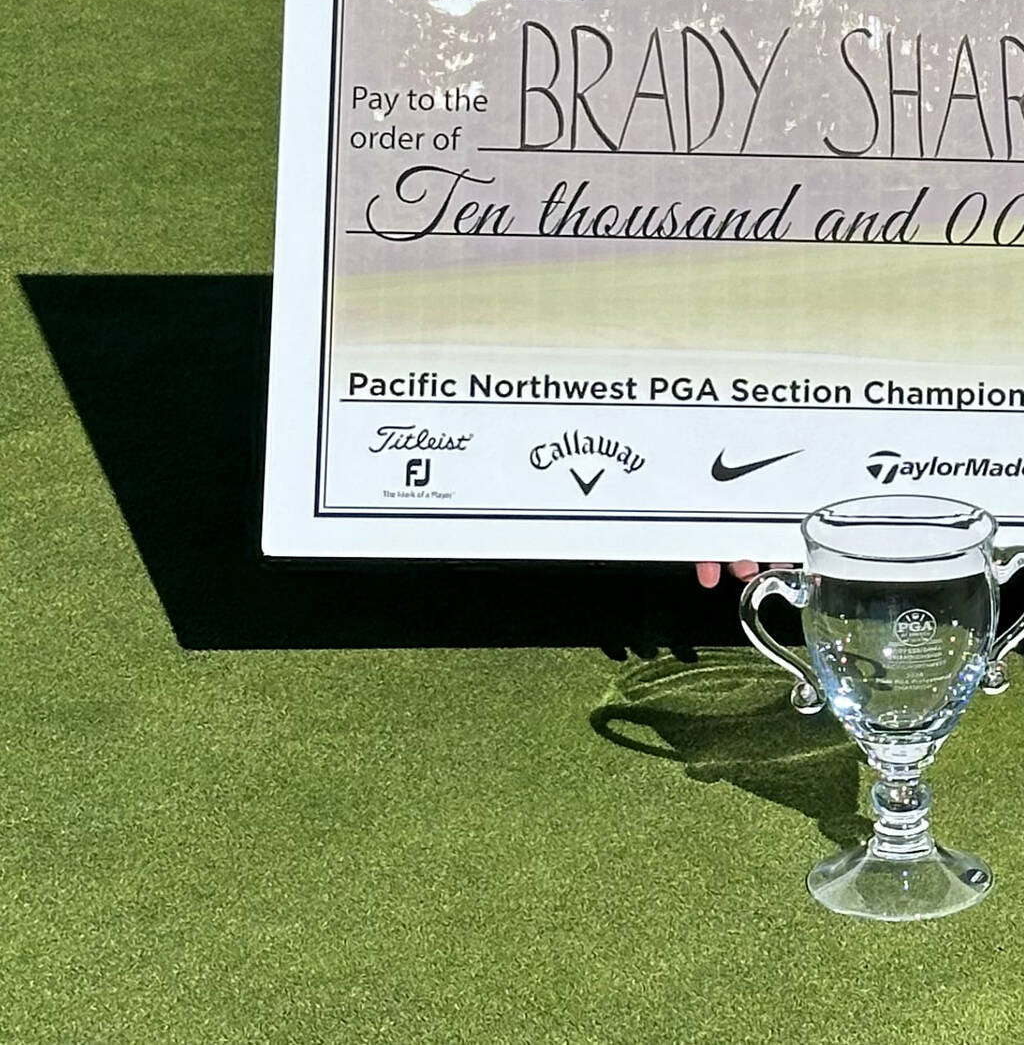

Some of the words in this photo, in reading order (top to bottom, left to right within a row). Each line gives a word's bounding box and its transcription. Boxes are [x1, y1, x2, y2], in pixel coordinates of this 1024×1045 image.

[352, 86, 399, 117] Pay
[407, 89, 435, 111] to
[445, 87, 489, 113] the
[520, 20, 791, 152] BRADY
[350, 125, 425, 151] order
[433, 126, 463, 151] of
[366, 164, 515, 242] Ten
[538, 180, 803, 241] thousand
[813, 186, 931, 244] and
[349, 372, 457, 397] Pacific
[469, 375, 637, 400] Northwest
[649, 378, 719, 402] PGA
[731, 378, 851, 404] Section
[368, 424, 473, 453] Titleist
[529, 429, 645, 474] Callaway
[405, 458, 431, 487] FJ
[897, 621, 933, 633] PGA
